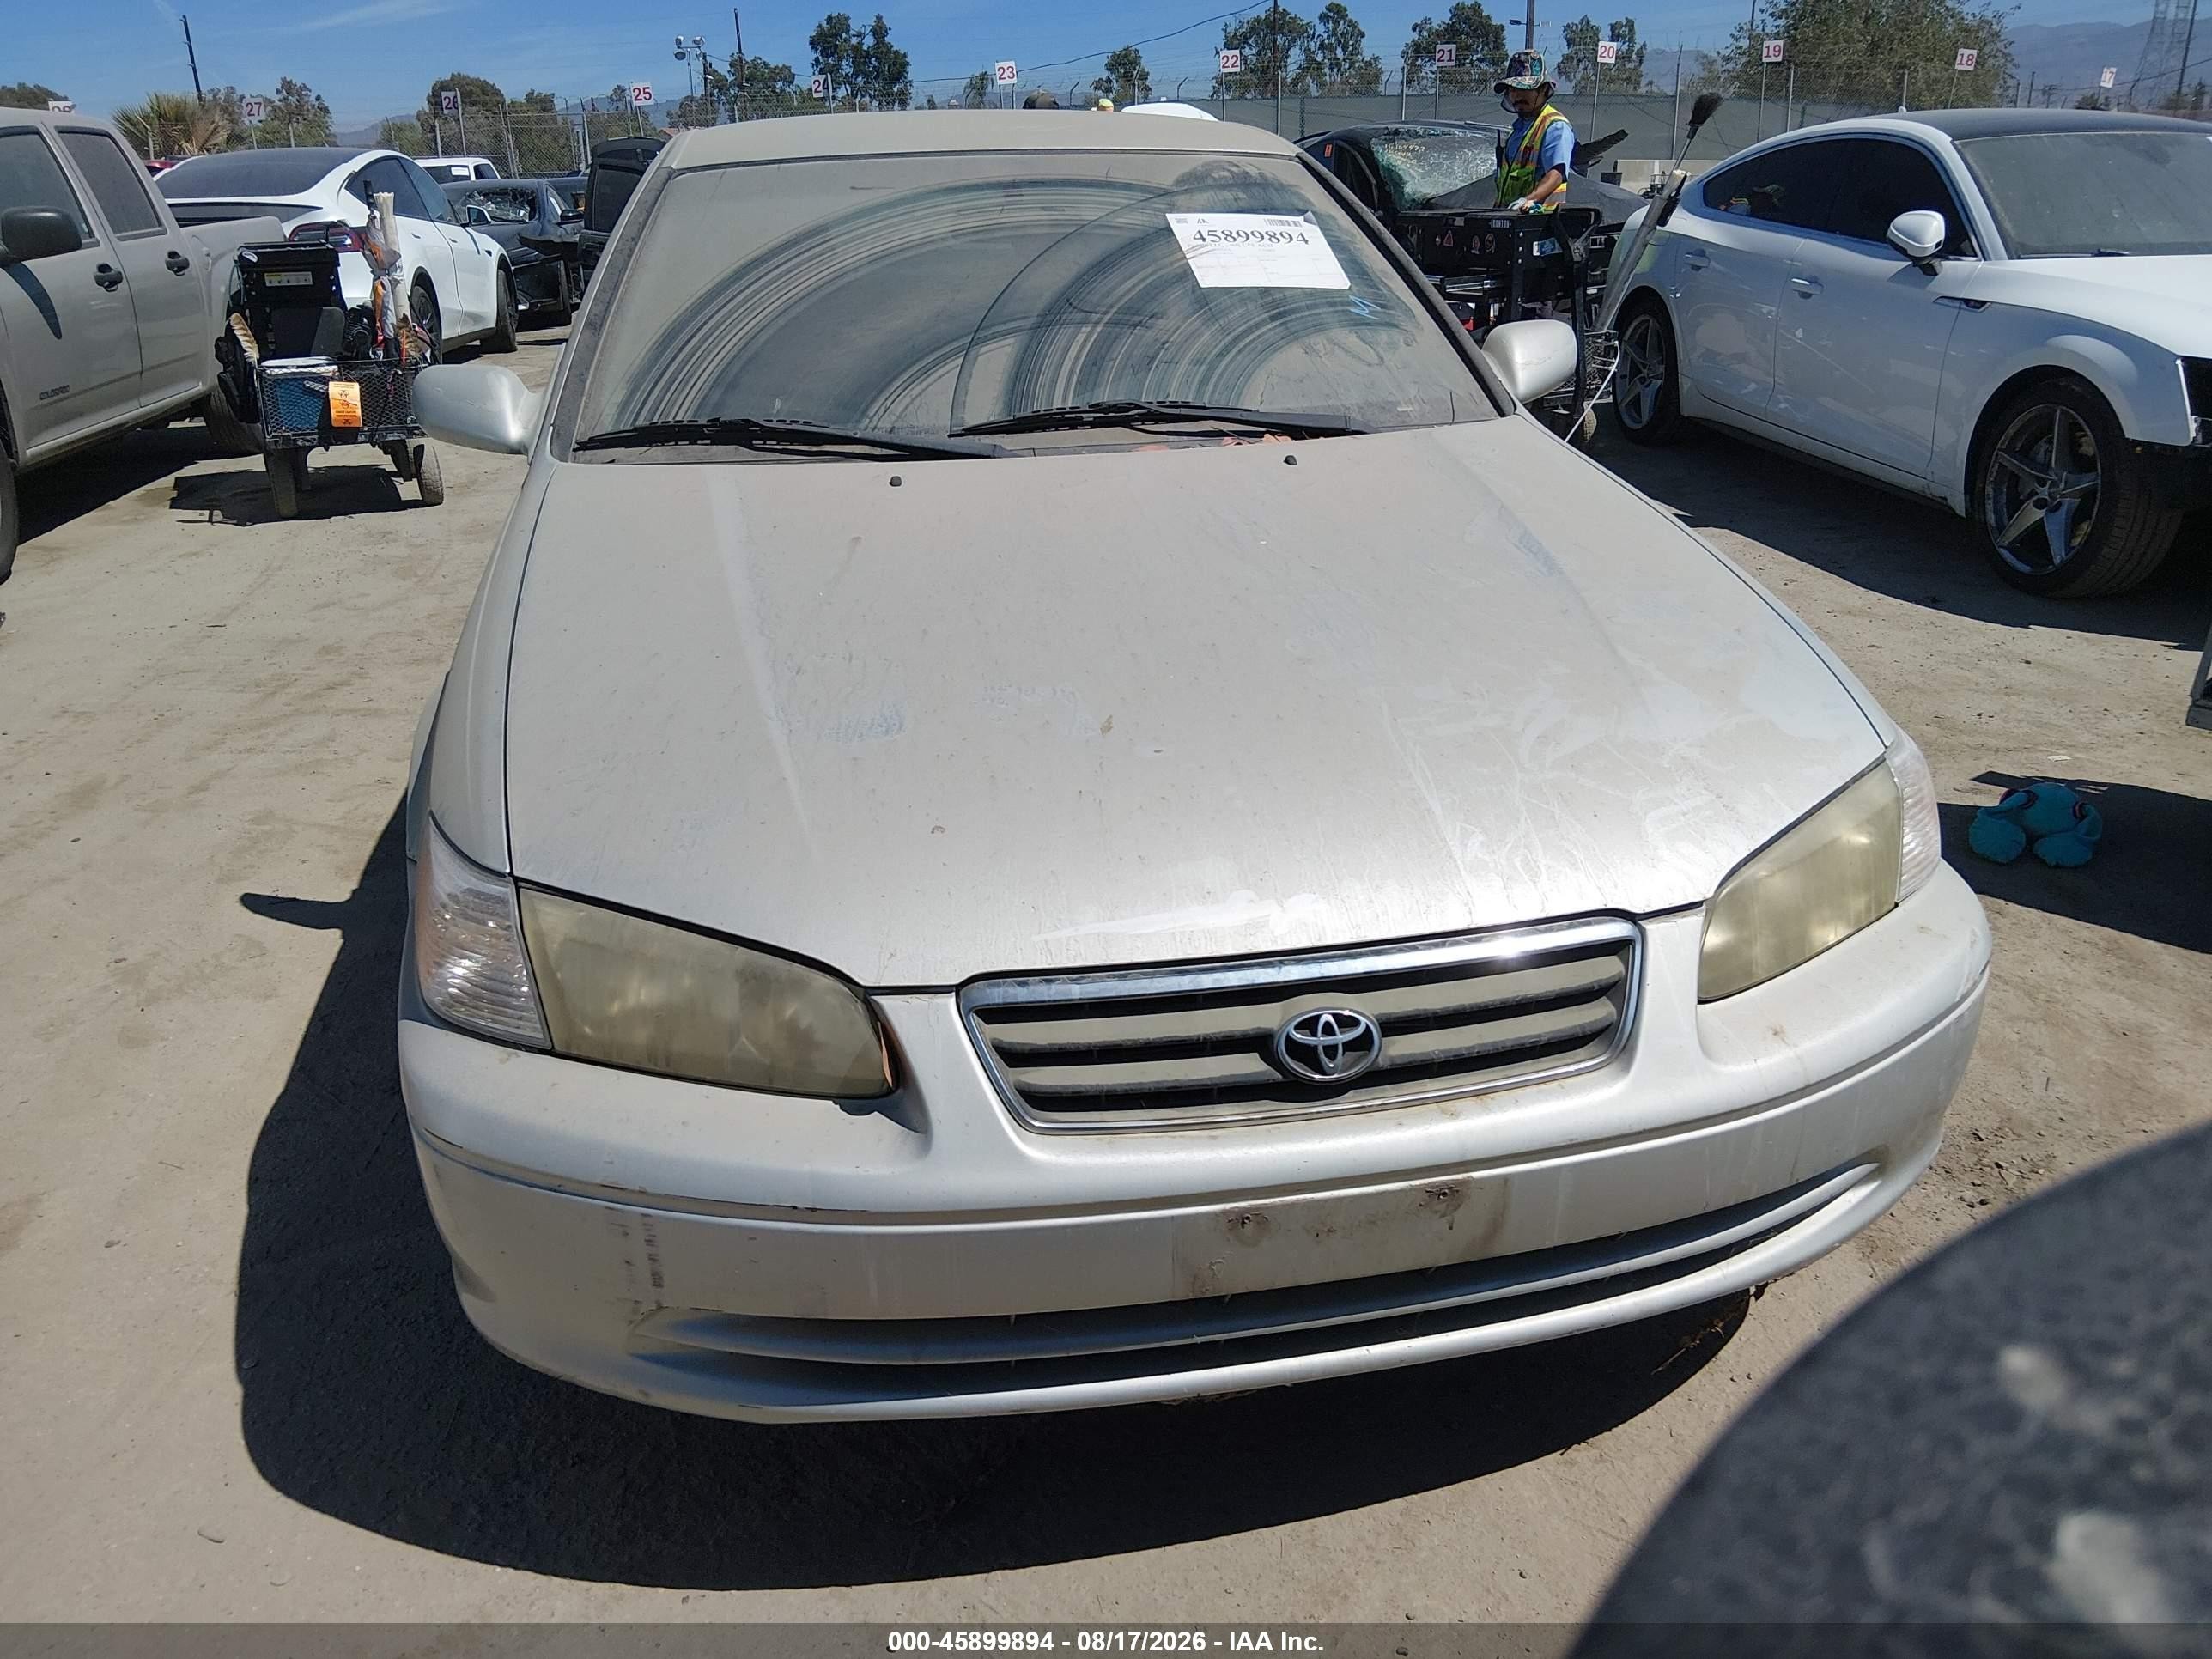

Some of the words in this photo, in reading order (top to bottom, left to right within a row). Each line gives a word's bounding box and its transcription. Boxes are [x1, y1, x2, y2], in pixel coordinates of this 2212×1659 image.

[1437, 48, 1455, 63] 21
[1598, 46, 1615, 59] 20
[1764, 45, 1781, 58] 19
[1221, 54, 1239, 69] 22
[1957, 53, 1974, 67] 18
[997, 66, 1015, 80] 23
[2102, 70, 2115, 83] 17
[632, 87, 653, 100] 25
[246, 102, 262, 117] 27
[1193, 229, 1310, 245] 45899894
